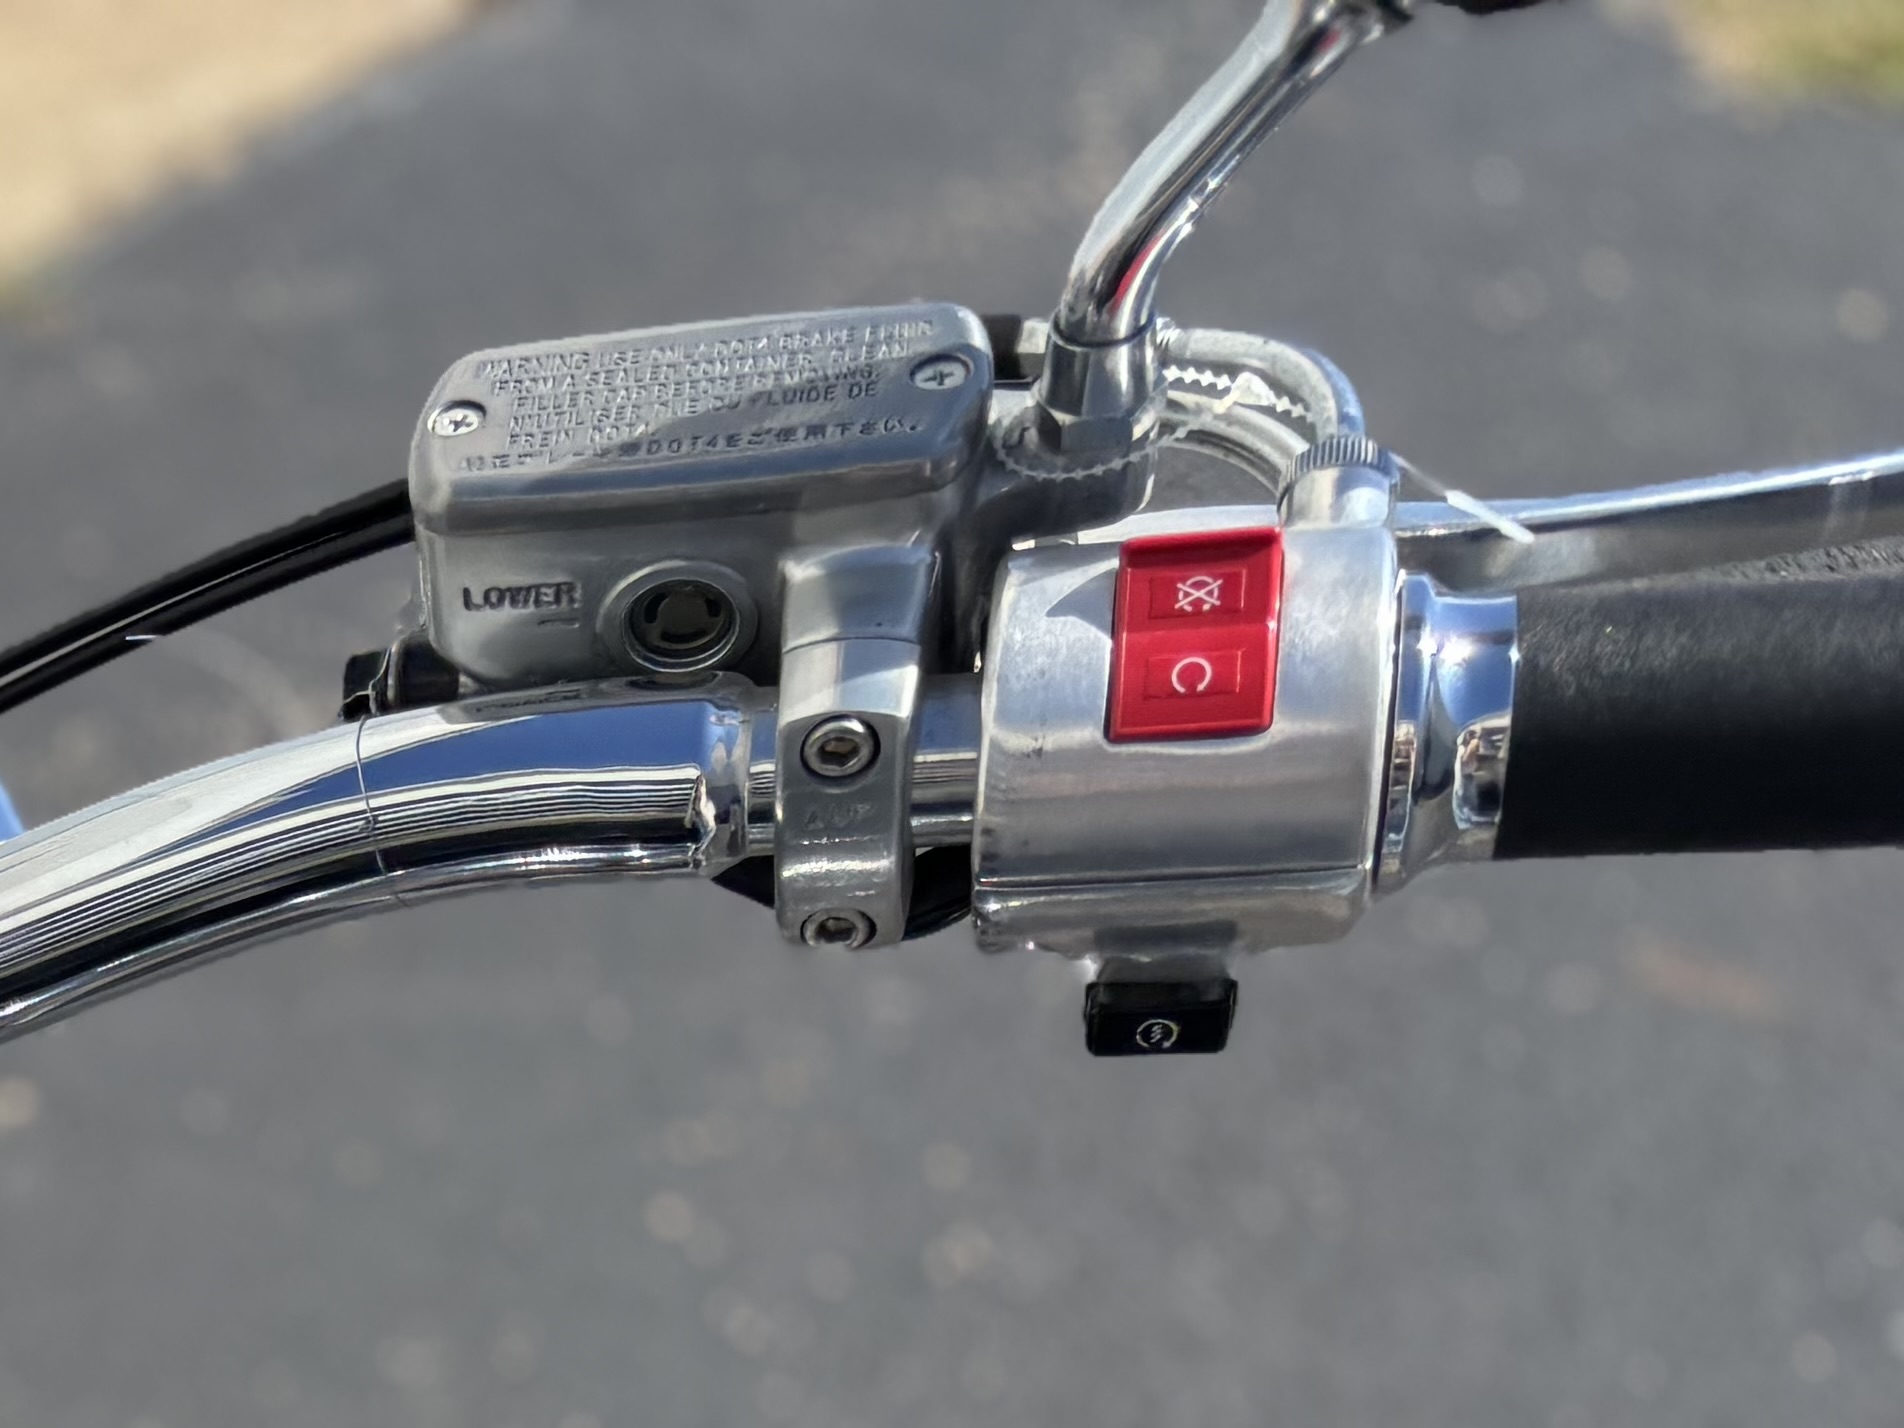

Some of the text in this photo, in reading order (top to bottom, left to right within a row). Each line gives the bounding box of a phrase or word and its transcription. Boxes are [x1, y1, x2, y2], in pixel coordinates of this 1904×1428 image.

[598, 348, 641, 368] USE
[779, 325, 857, 350] BRAKE
[562, 372, 576, 392] A
[748, 384, 837, 408] FLUIDE
[847, 379, 879, 399] DE
[513, 390, 593, 412] FILLER
[506, 428, 573, 450] FREIN
[463, 580, 582, 612] LOWER
[830, 803, 873, 828] UP
